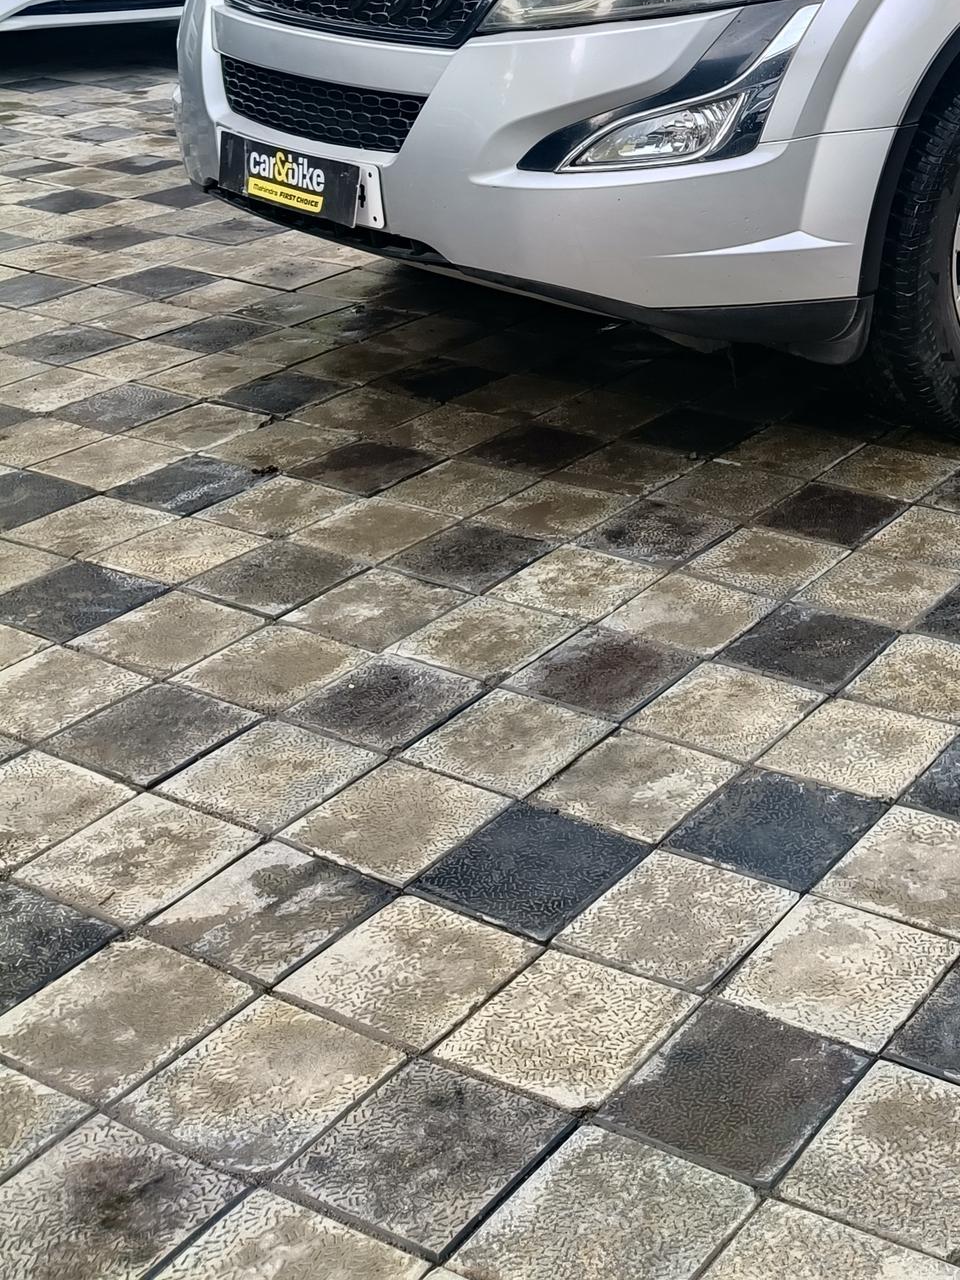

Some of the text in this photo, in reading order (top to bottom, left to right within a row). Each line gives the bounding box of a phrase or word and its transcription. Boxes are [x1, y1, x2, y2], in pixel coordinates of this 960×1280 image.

[249, 151, 325, 193] car&bike
[279, 191, 296, 201] FIRST
[296, 196, 319, 208] CHOICE
